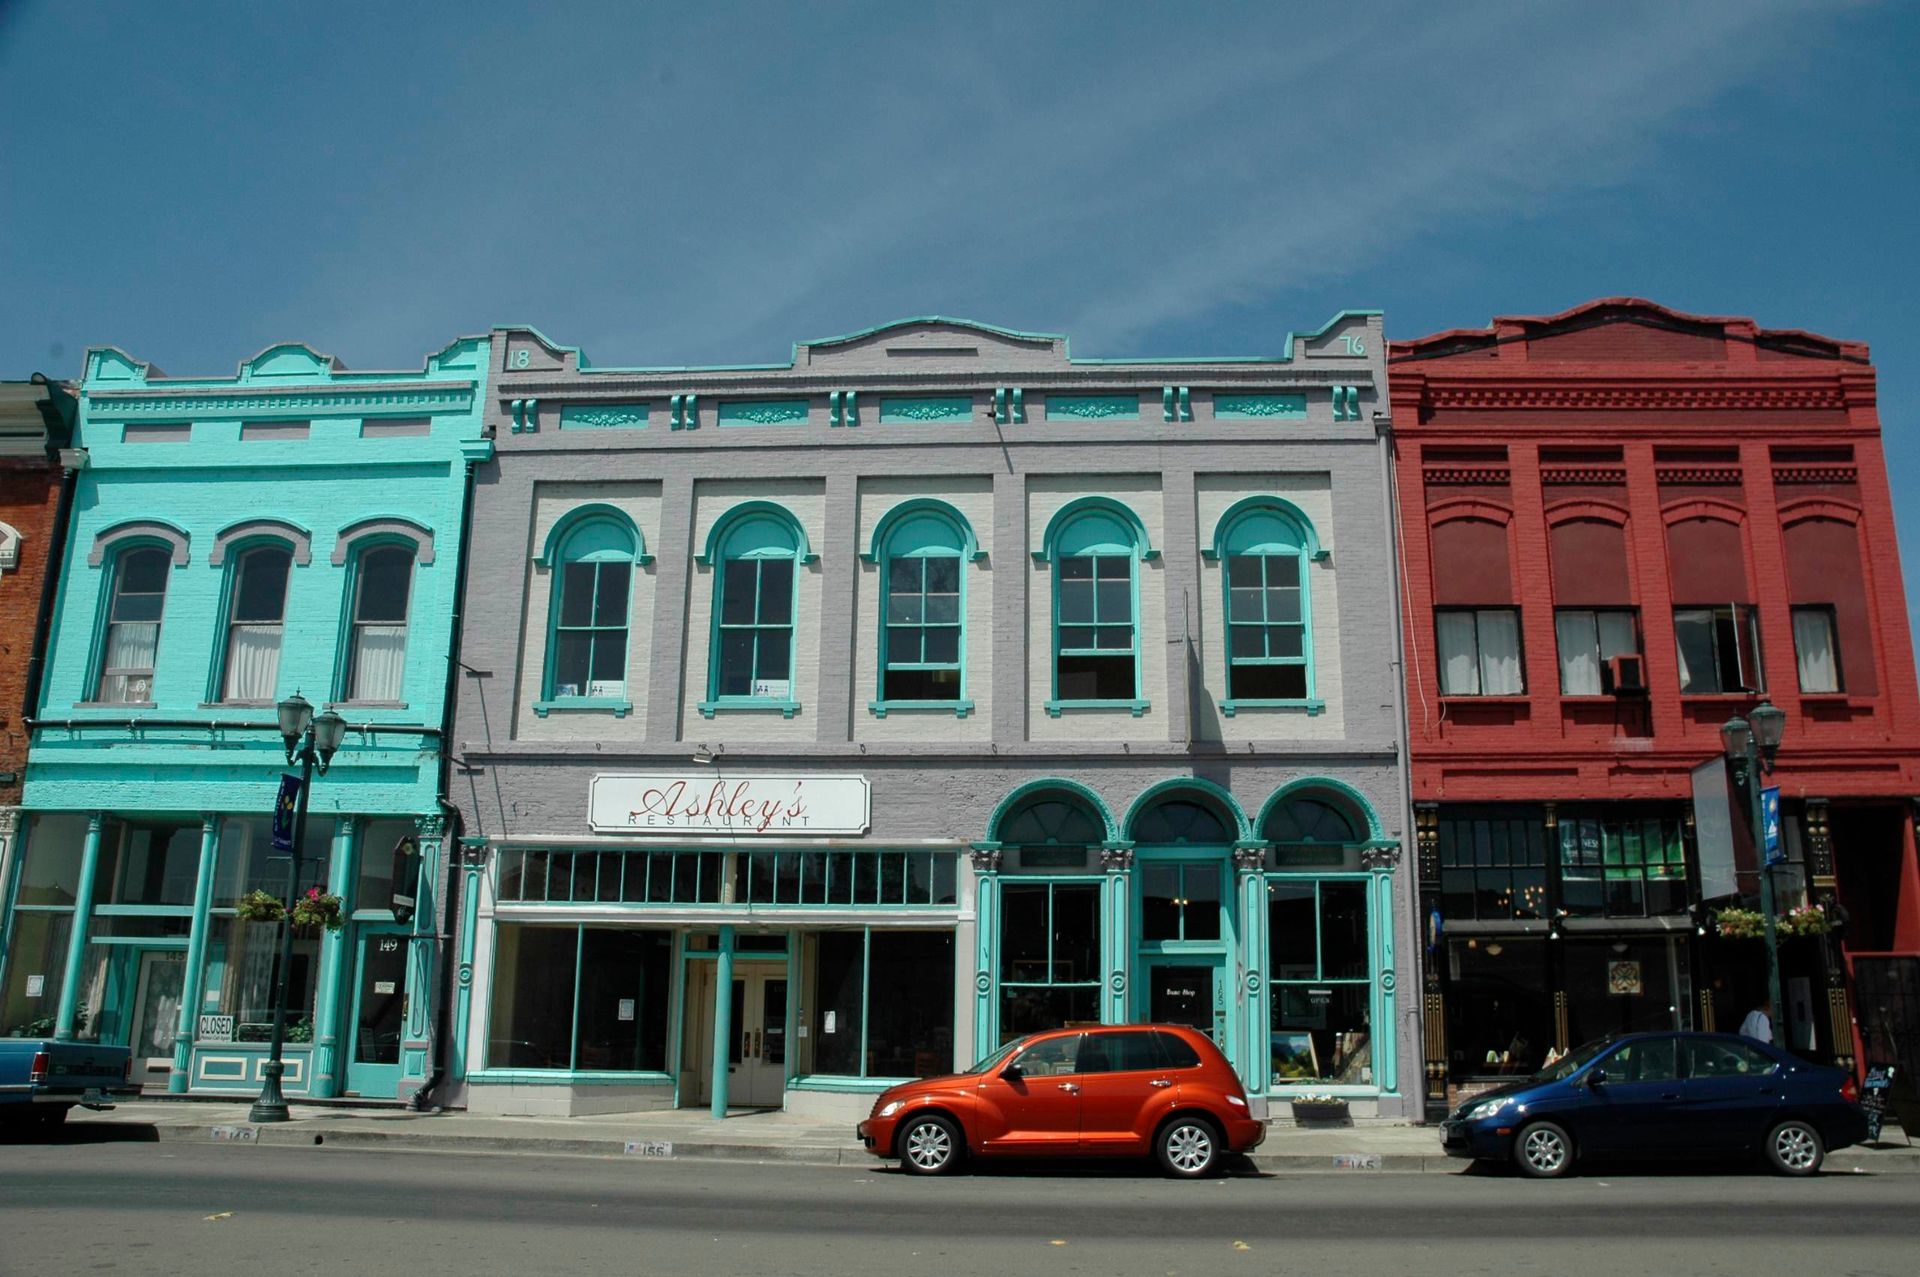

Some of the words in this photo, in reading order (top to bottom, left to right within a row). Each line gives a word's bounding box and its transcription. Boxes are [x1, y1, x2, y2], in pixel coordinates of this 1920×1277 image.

[1338, 335, 1365, 355] 76
[510, 350, 529, 369] 18
[629, 780, 808, 832] Ashley's
[628, 814, 810, 827] RESTAURANT
[380, 939, 398, 951] 149
[200, 1016, 232, 1035] CLOSED
[642, 1145, 665, 1156] 155
